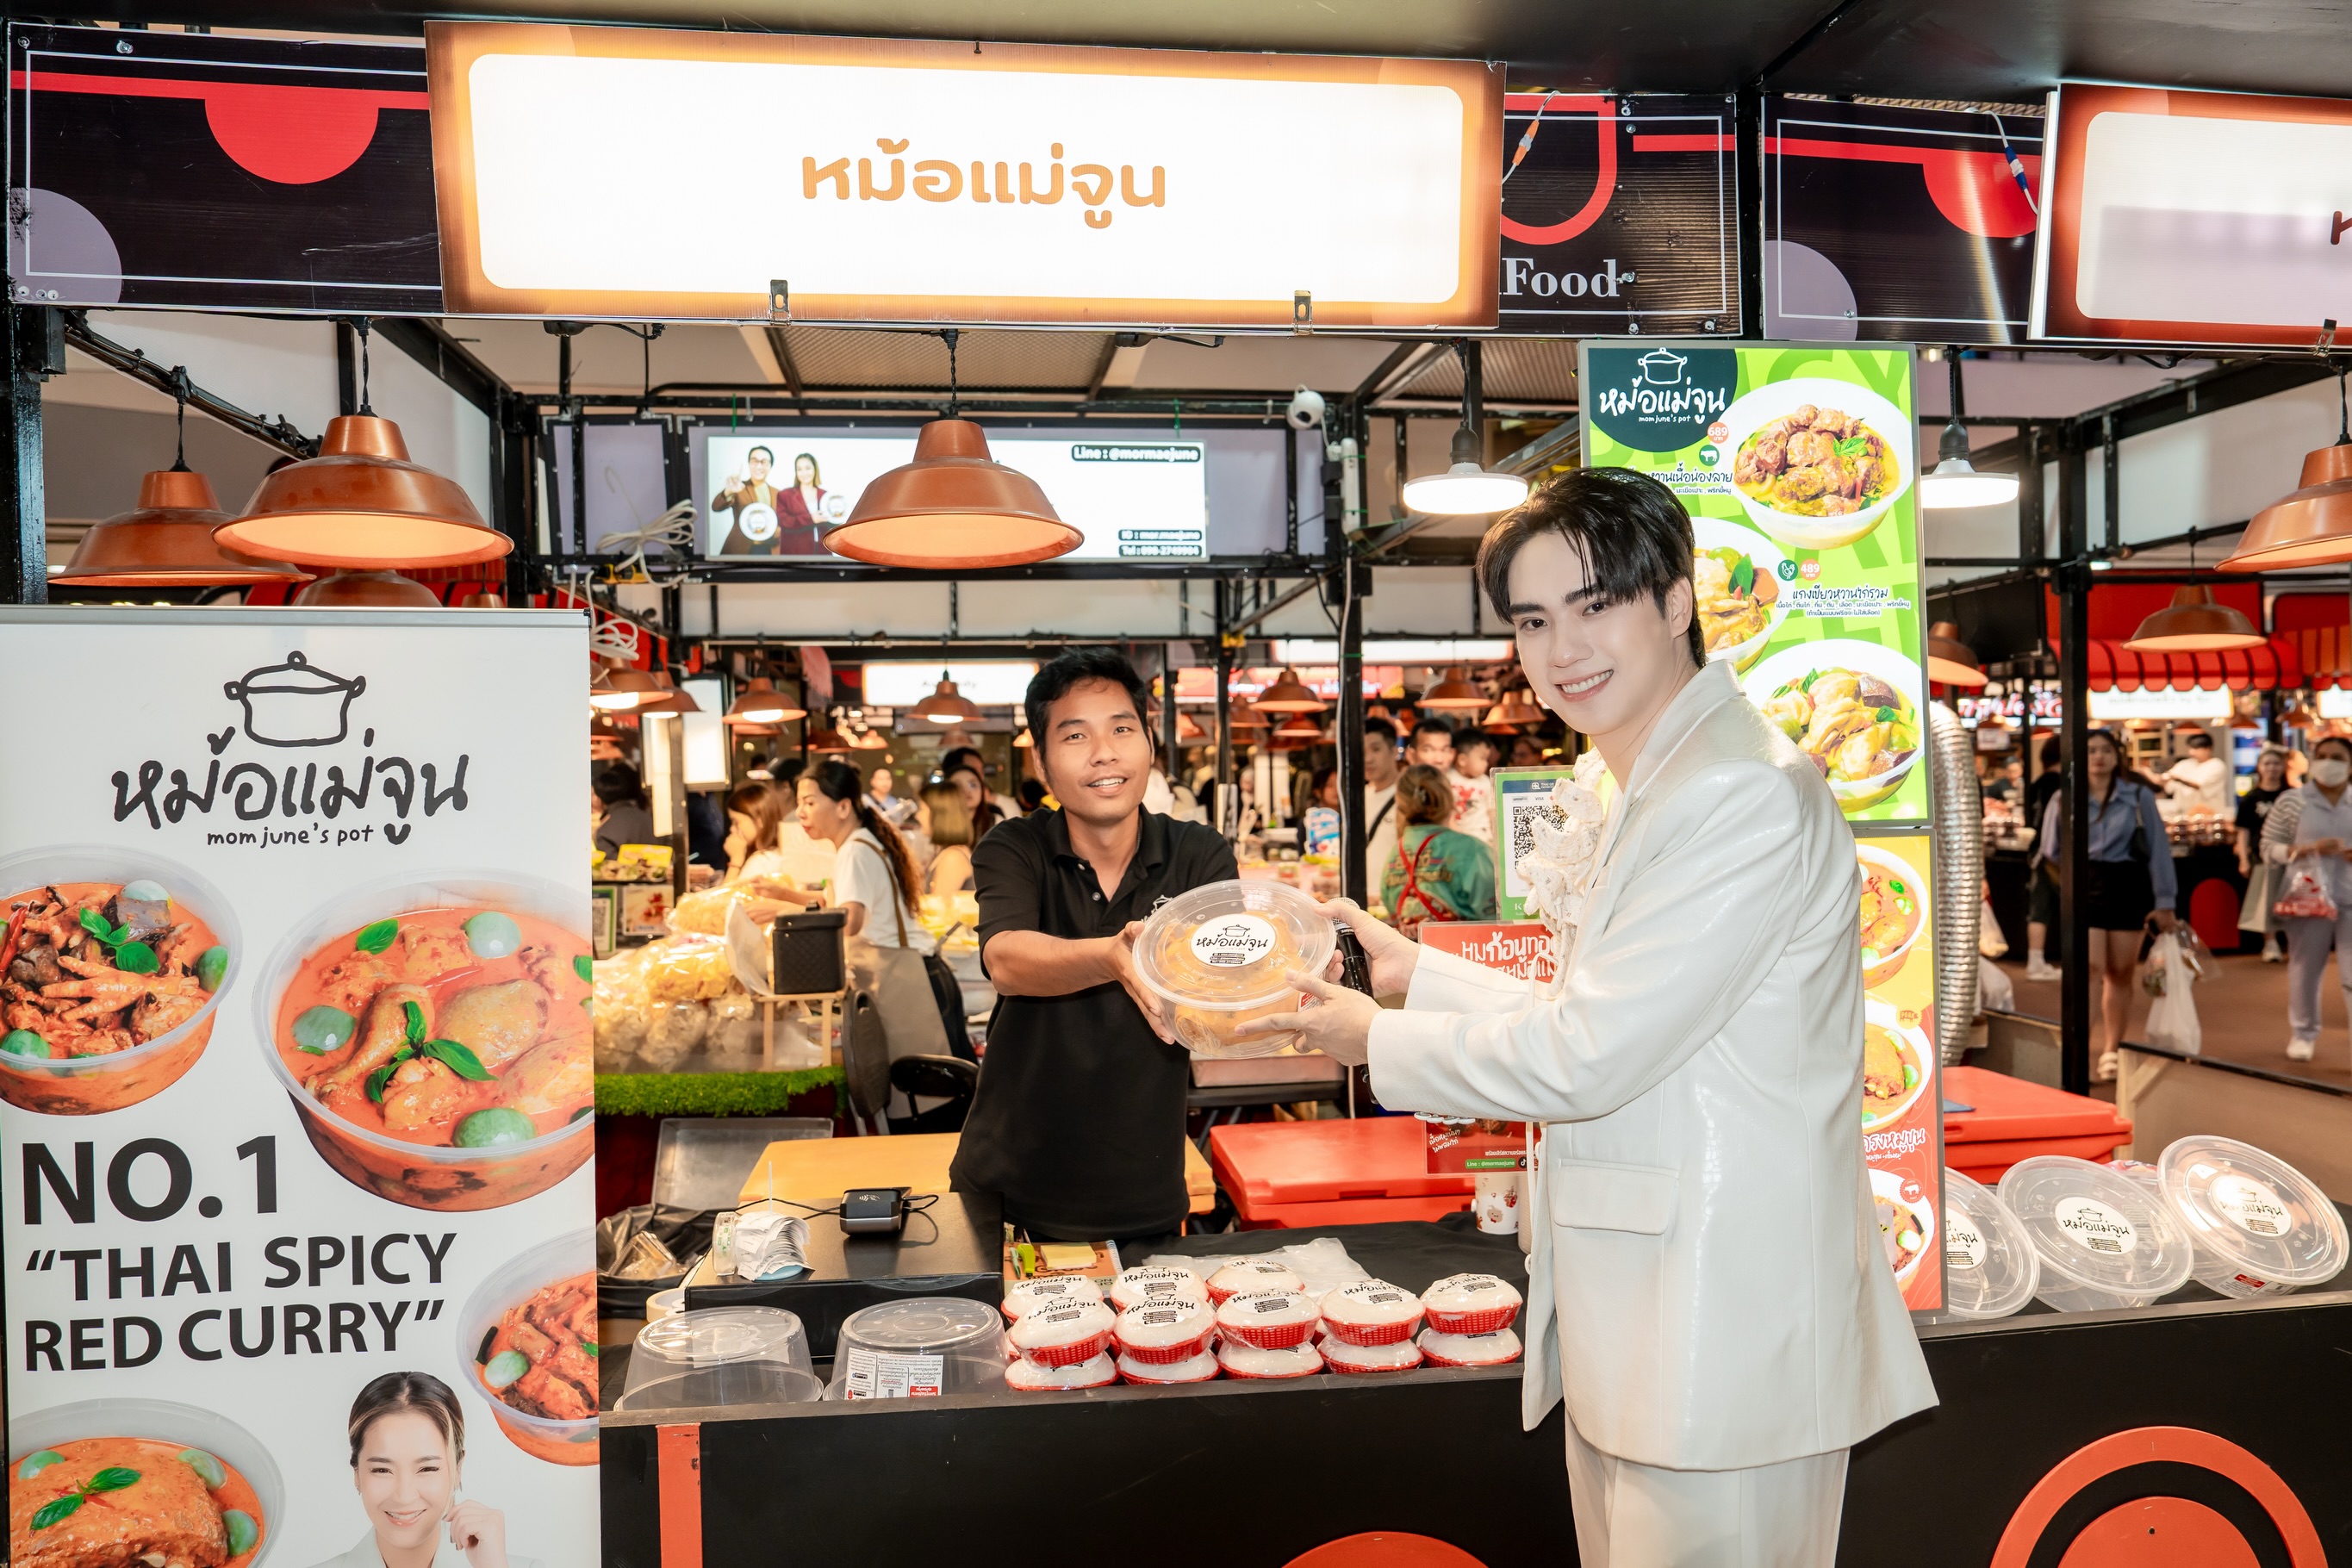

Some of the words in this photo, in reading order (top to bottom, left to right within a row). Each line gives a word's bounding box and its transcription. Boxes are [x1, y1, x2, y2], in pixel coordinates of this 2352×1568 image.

[802, 138, 1166, 229] หม้อแม่จูน
[1499, 258, 1621, 298] Food
[1599, 375, 1726, 425] หม้อแม่จูน
[1655, 414, 1677, 424] june's
[1677, 414, 1691, 424] pot
[1707, 426, 1728, 437] 689
[1073, 445, 1102, 460] Line
[1800, 563, 1820, 574] 489
[111, 726, 470, 845] หม้อแม่จูน
[207, 831, 257, 846] mom
[259, 823, 330, 849] june's
[337, 824, 374, 846] pot
[1196, 933, 1268, 952] หม้อแม่จูน
[22, 1135, 278, 1225] NO.1
[2063, 1216, 2130, 1238] หม้อแม่จูน
[264, 1232, 457, 1289] SPICY
[1124, 1270, 1189, 1283] หม้อแม่จูน
[25, 1316, 163, 1372] RED
